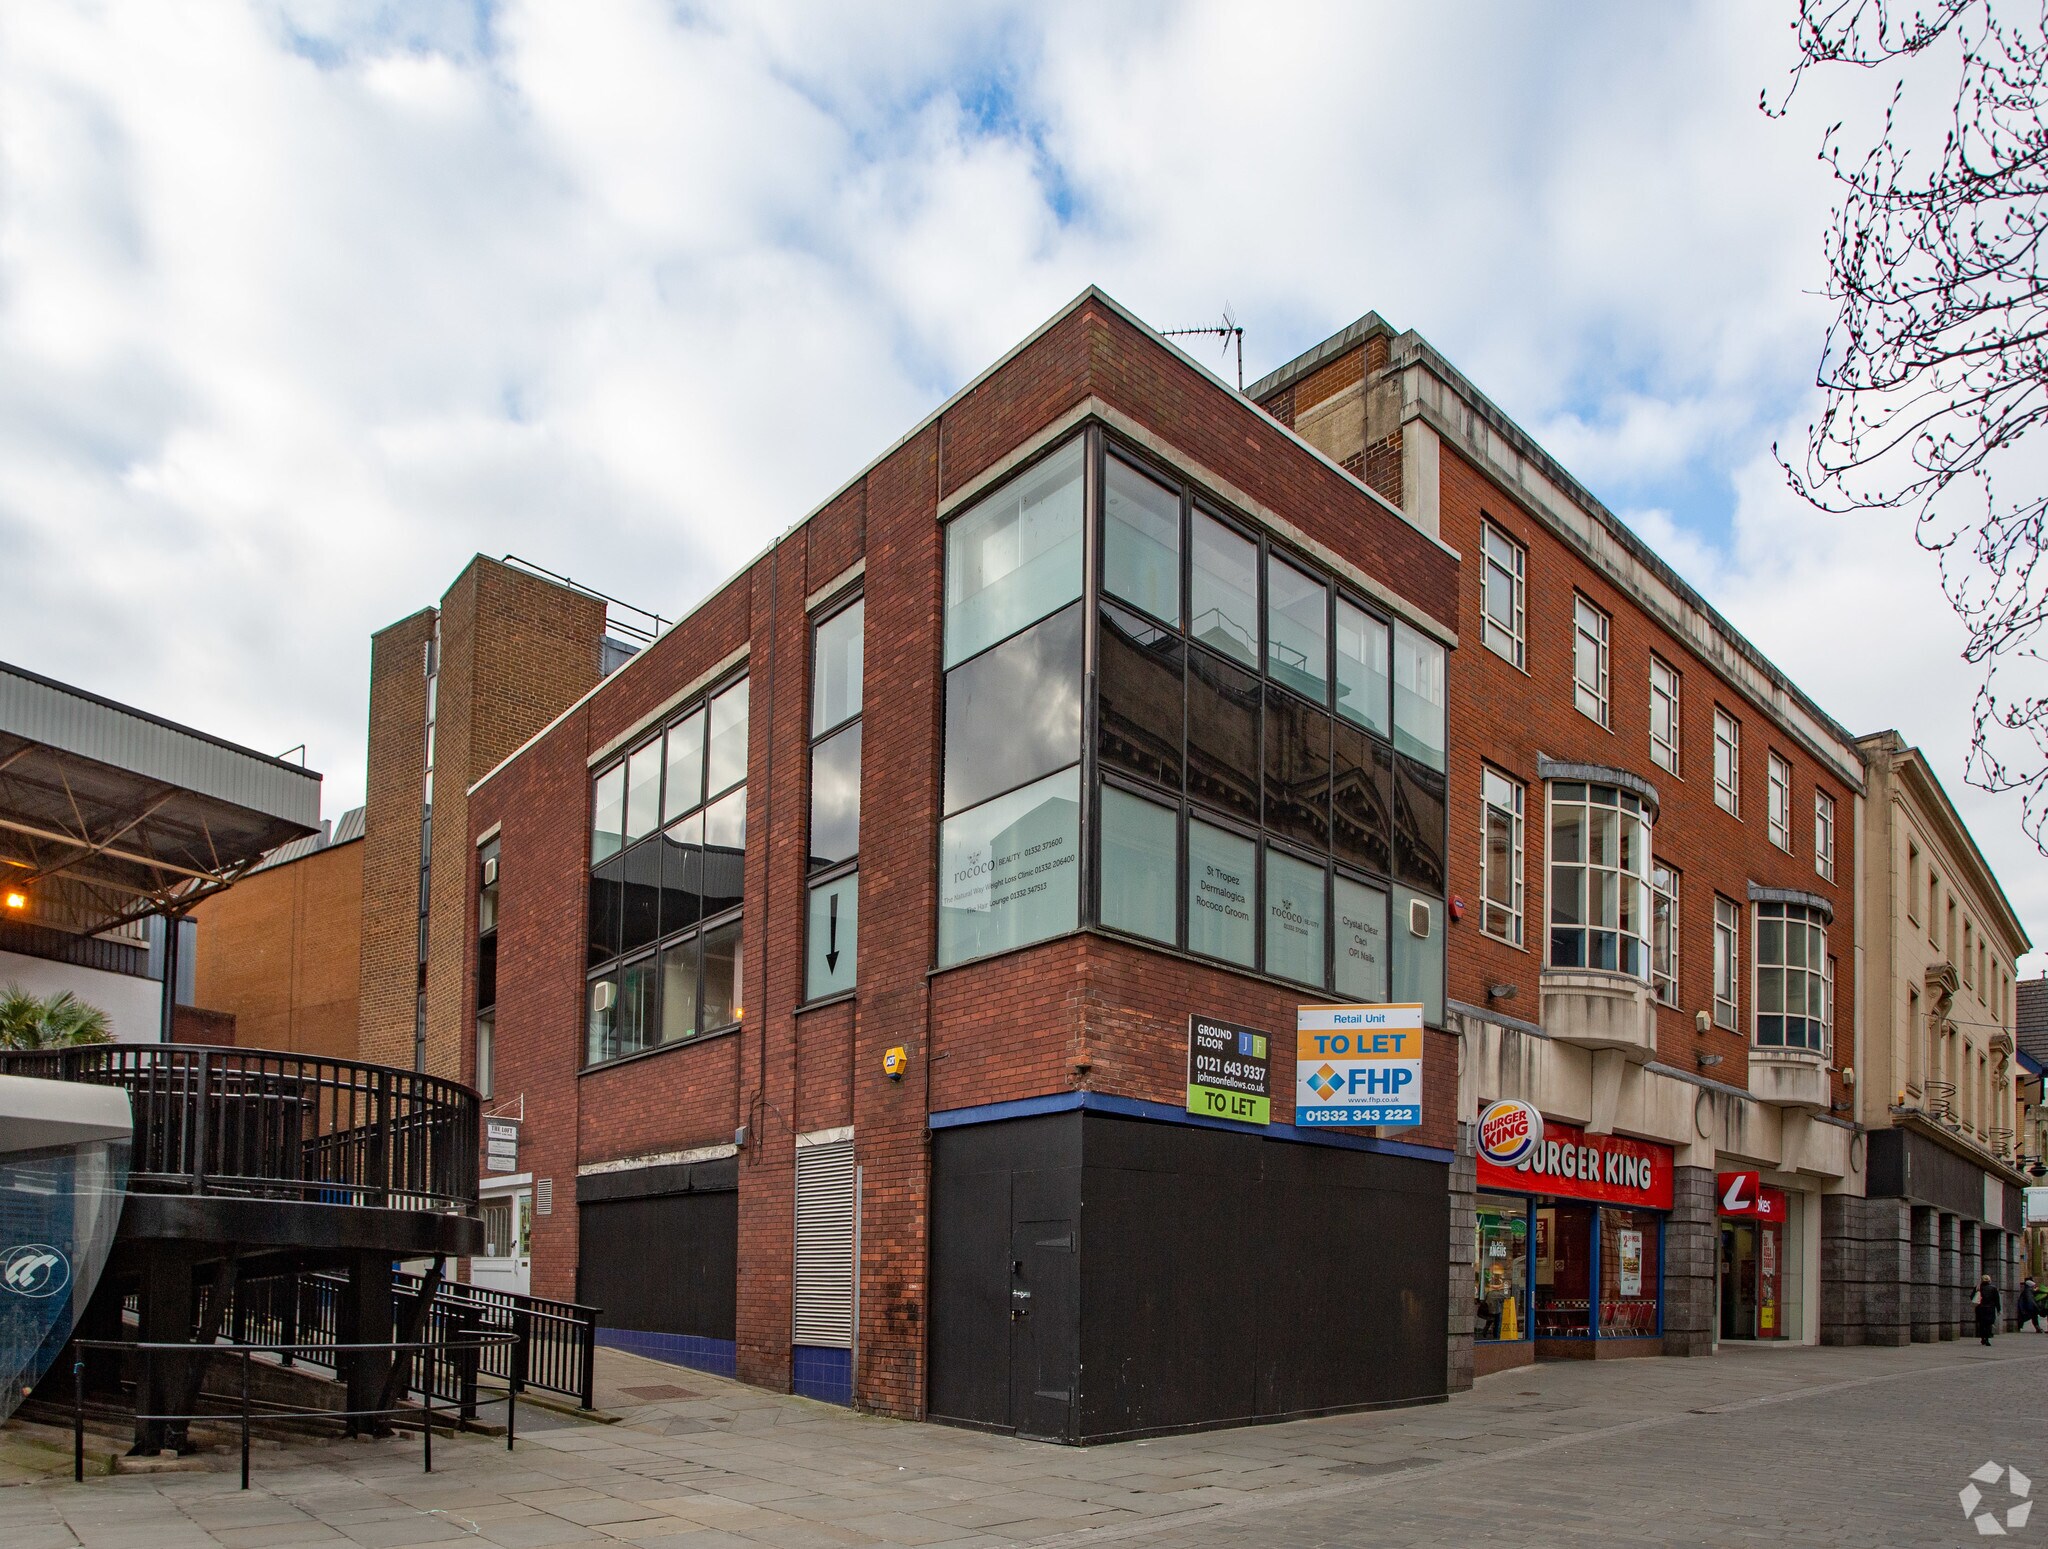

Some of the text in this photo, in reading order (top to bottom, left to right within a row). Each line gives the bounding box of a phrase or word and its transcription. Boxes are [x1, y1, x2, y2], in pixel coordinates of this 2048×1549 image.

[954, 837, 1063, 884] rococo BEAUTY 01332 371600
[954, 890, 973, 901] Natural
[973, 886, 984, 896] Way
[984, 879, 1004, 892] Weight
[1004, 875, 1017, 885] Loss
[1018, 869, 1034, 880] Clinic
[1034, 863, 1052, 874] 01332
[1052, 854, 1075, 868] 206400
[1206, 866, 1240, 886] St Tropez
[977, 903, 988, 911] Hair
[990, 895, 1009, 908] Lounge
[1010, 889, 1027, 900] 01332
[1027, 882, 1048, 895] 347513
[1200, 879, 1246, 904] Dermalogica
[1196, 895, 1249, 921] Rococo Groom
[1271, 906, 1303, 924] rococo
[1342, 916, 1379, 935] Crystal Clear
[1354, 935, 1367, 946] Caci
[1348, 947, 1375, 963] OPI Nails
[1334, 1014, 1385, 1024] Retail Unit
[1198, 1024, 1232, 1040] GROUND
[1197, 1036, 1223, 1050] FLOOR
[1314, 1034, 1406, 1054] TO LET
[1197, 1055, 1266, 1081] 0121 643 9337
[1197, 1071, 1265, 1093] johnsonfellows.co.uk
[1348, 1068, 1412, 1095] FHP
[1205, 1091, 1256, 1117] TO LET
[1348, 1096, 1400, 1104] www.fhp.co.uk
[1306, 1109, 1412, 1122] 01332 343 222
[1483, 1110, 1527, 1136] BURGER
[1484, 1120, 1529, 1152] KING
[1605, 1151, 1651, 1190] KING
[1489, 1246, 1507, 1257] ANGUS
